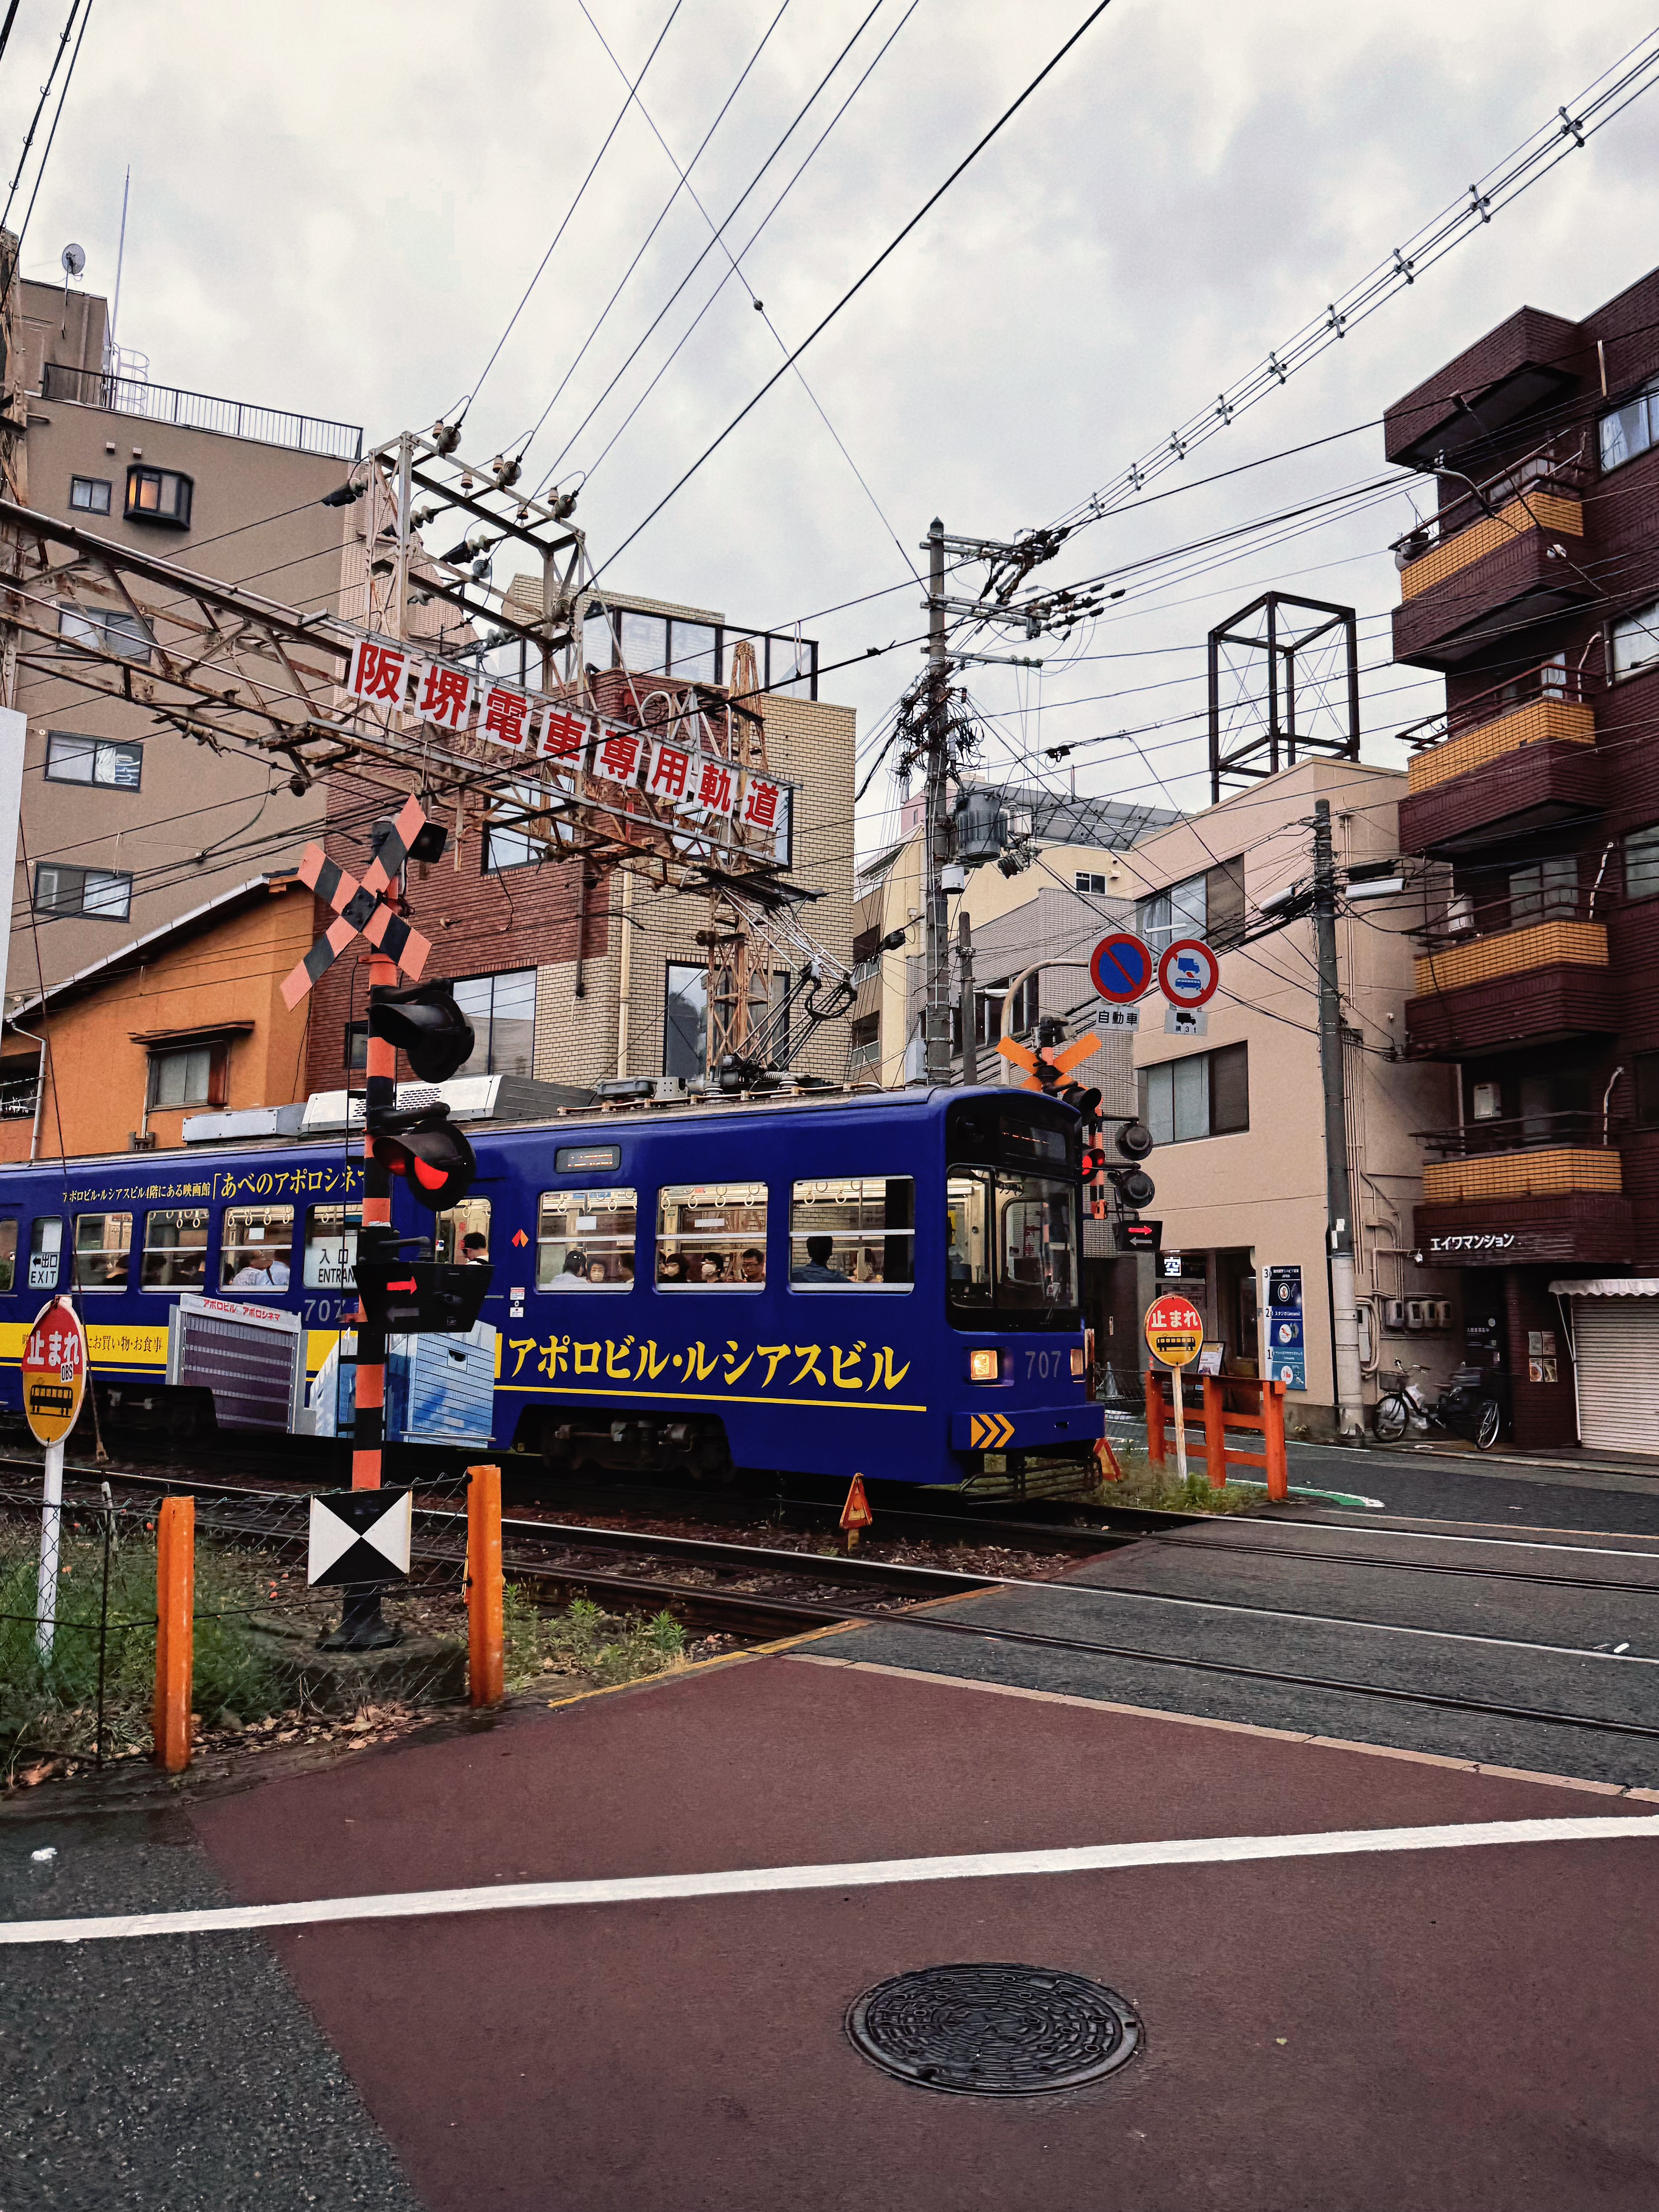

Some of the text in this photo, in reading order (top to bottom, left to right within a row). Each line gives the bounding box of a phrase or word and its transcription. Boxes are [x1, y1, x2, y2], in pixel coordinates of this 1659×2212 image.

[1099, 1010, 1137, 1025] 自動車
[1431, 1234, 1514, 1251] エイワマンション
[42, 1255, 57, 1267] 出口
[319, 1249, 348, 1264] 入口
[31, 1271, 56, 1283] EXIT
[203, 1299, 281, 1321] アポロビル アポロシネマ
[305, 1299, 346, 1322] 707
[1151, 1310, 1198, 1327] 止まれ
[27, 1331, 79, 1366] 止まれ
[62, 1363, 73, 1381] OBS
[509, 1335, 910, 1392] アポロビル・ルシアスビル
[1025, 1351, 1061, 1379] 707
